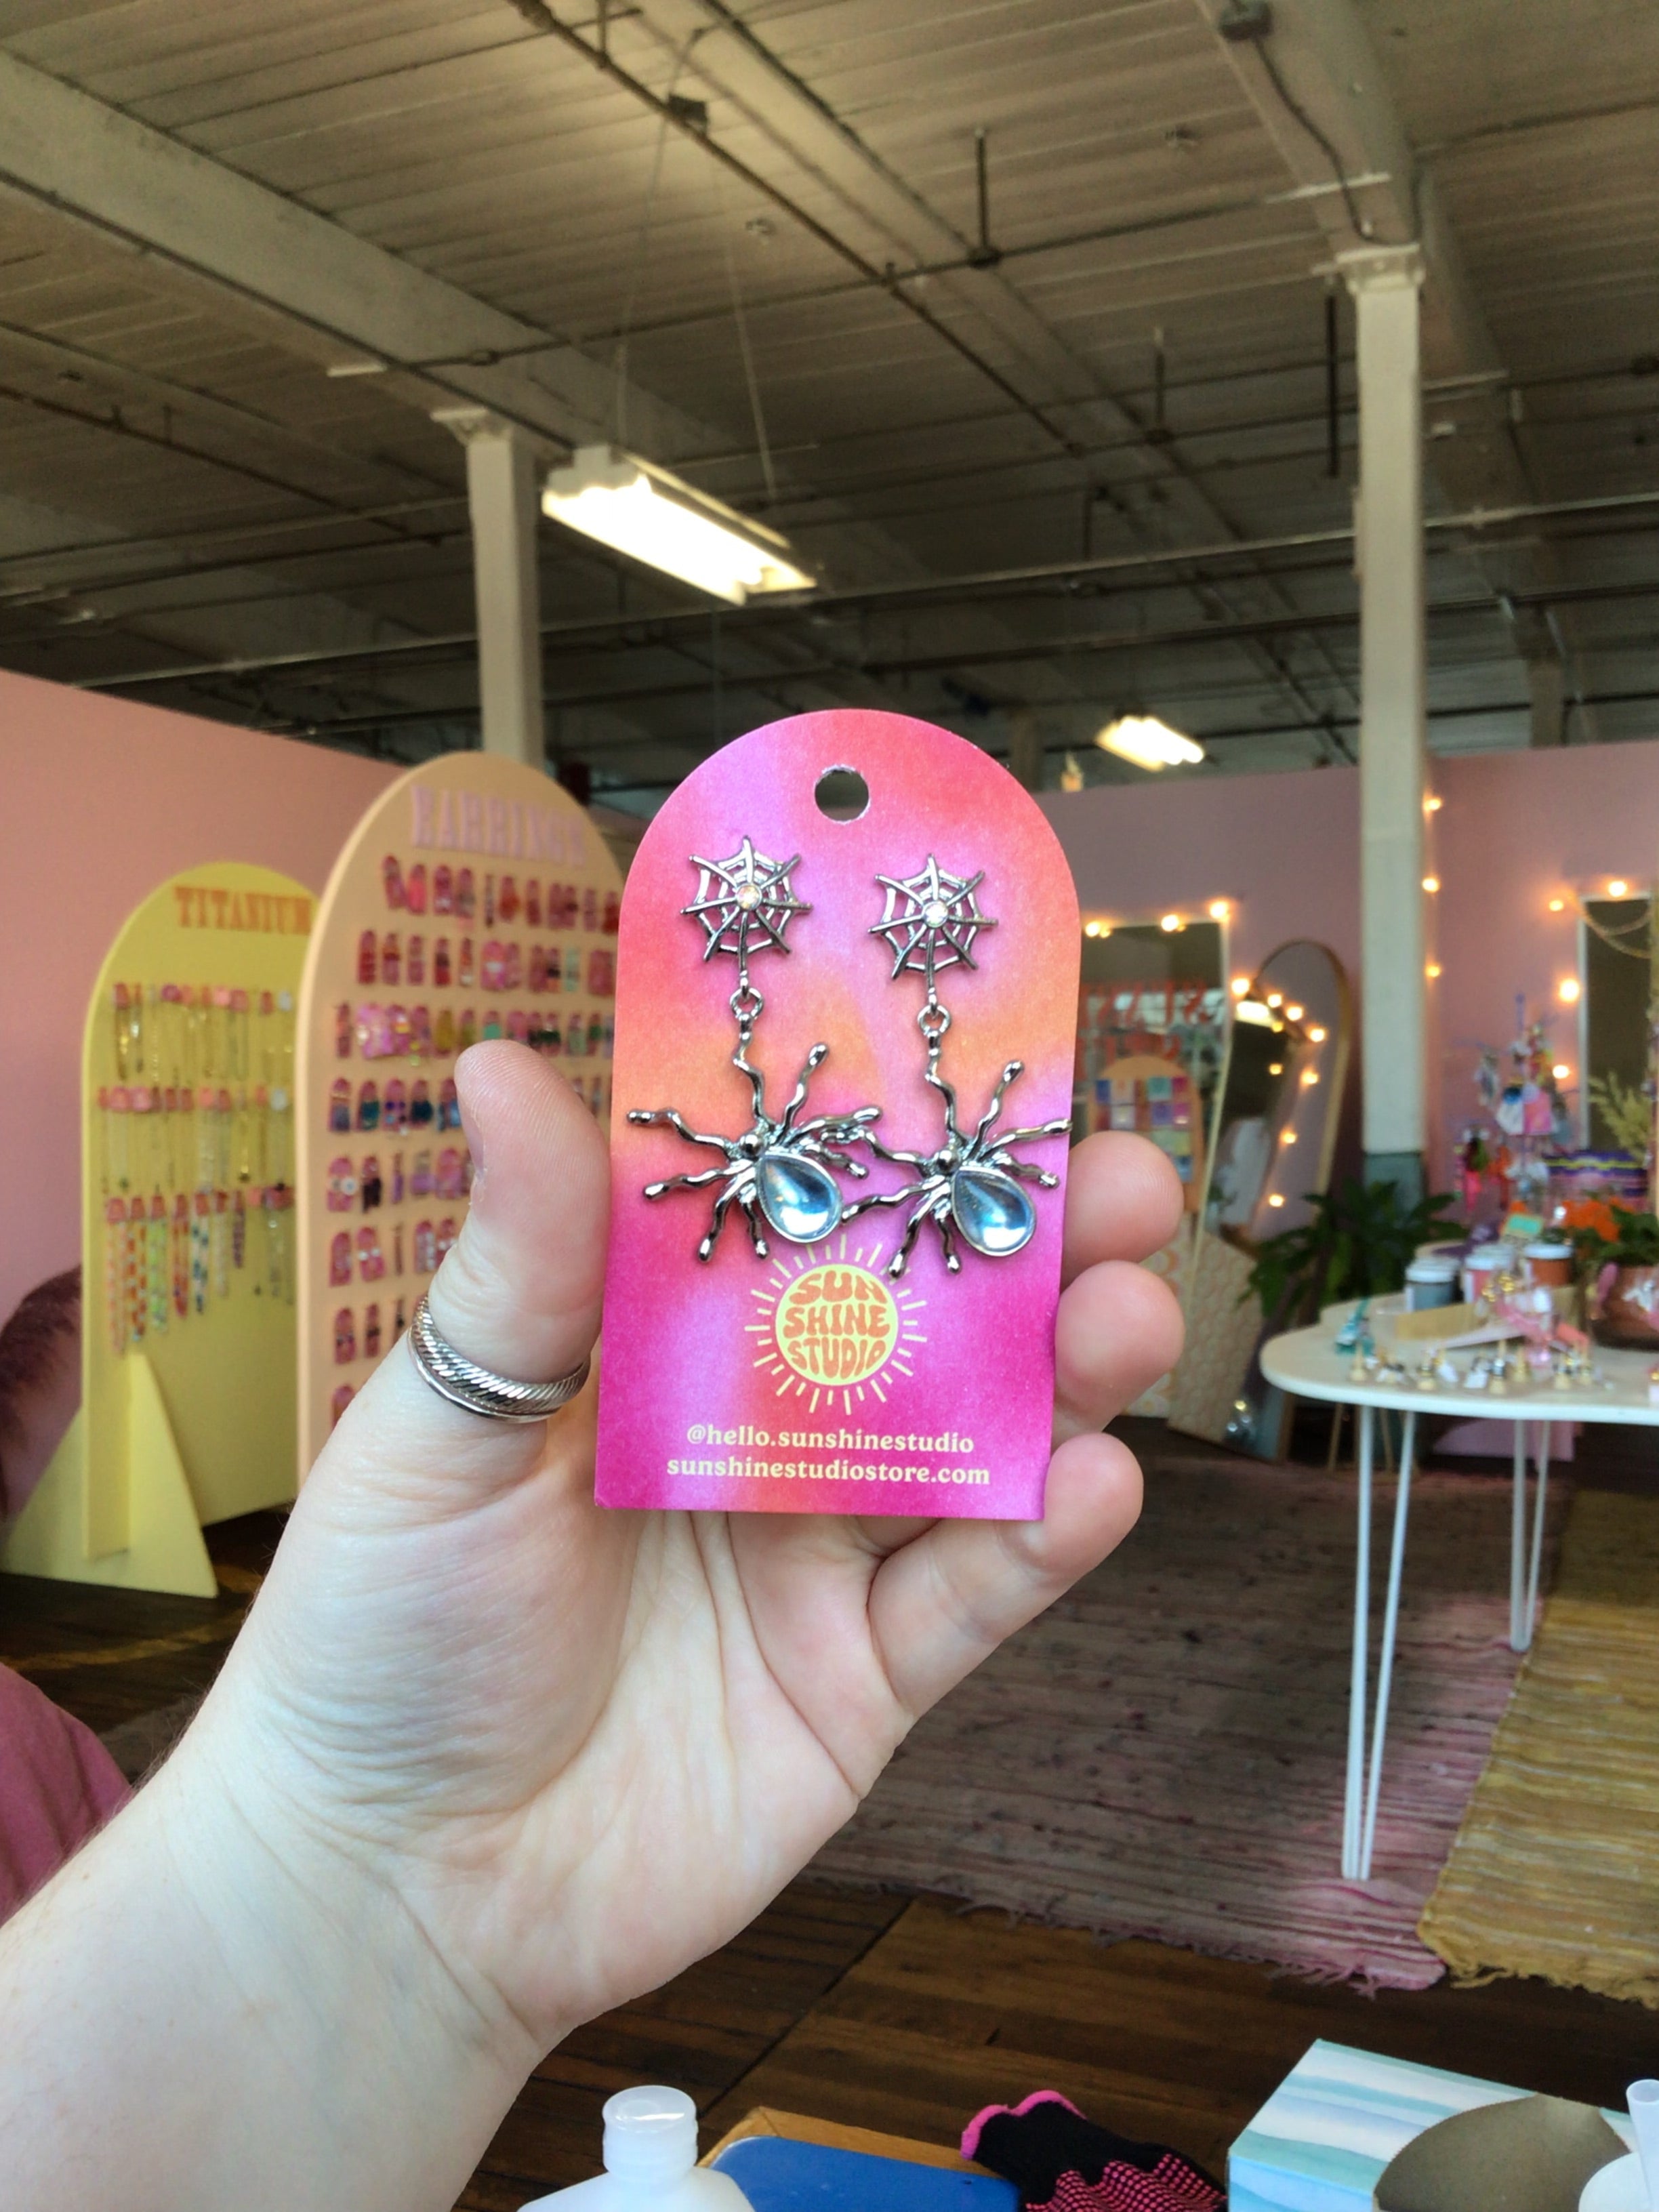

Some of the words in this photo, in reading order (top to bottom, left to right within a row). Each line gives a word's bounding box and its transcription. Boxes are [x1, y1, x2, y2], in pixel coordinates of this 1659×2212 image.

[789, 1269, 888, 1305] SUN
[783, 1303, 891, 1339] SHINE
[787, 1337, 887, 1380] STUDIO
[686, 1424, 975, 1454] @hello.sunshinestudio
[666, 1456, 991, 1485] sunshinestudiostore.com
